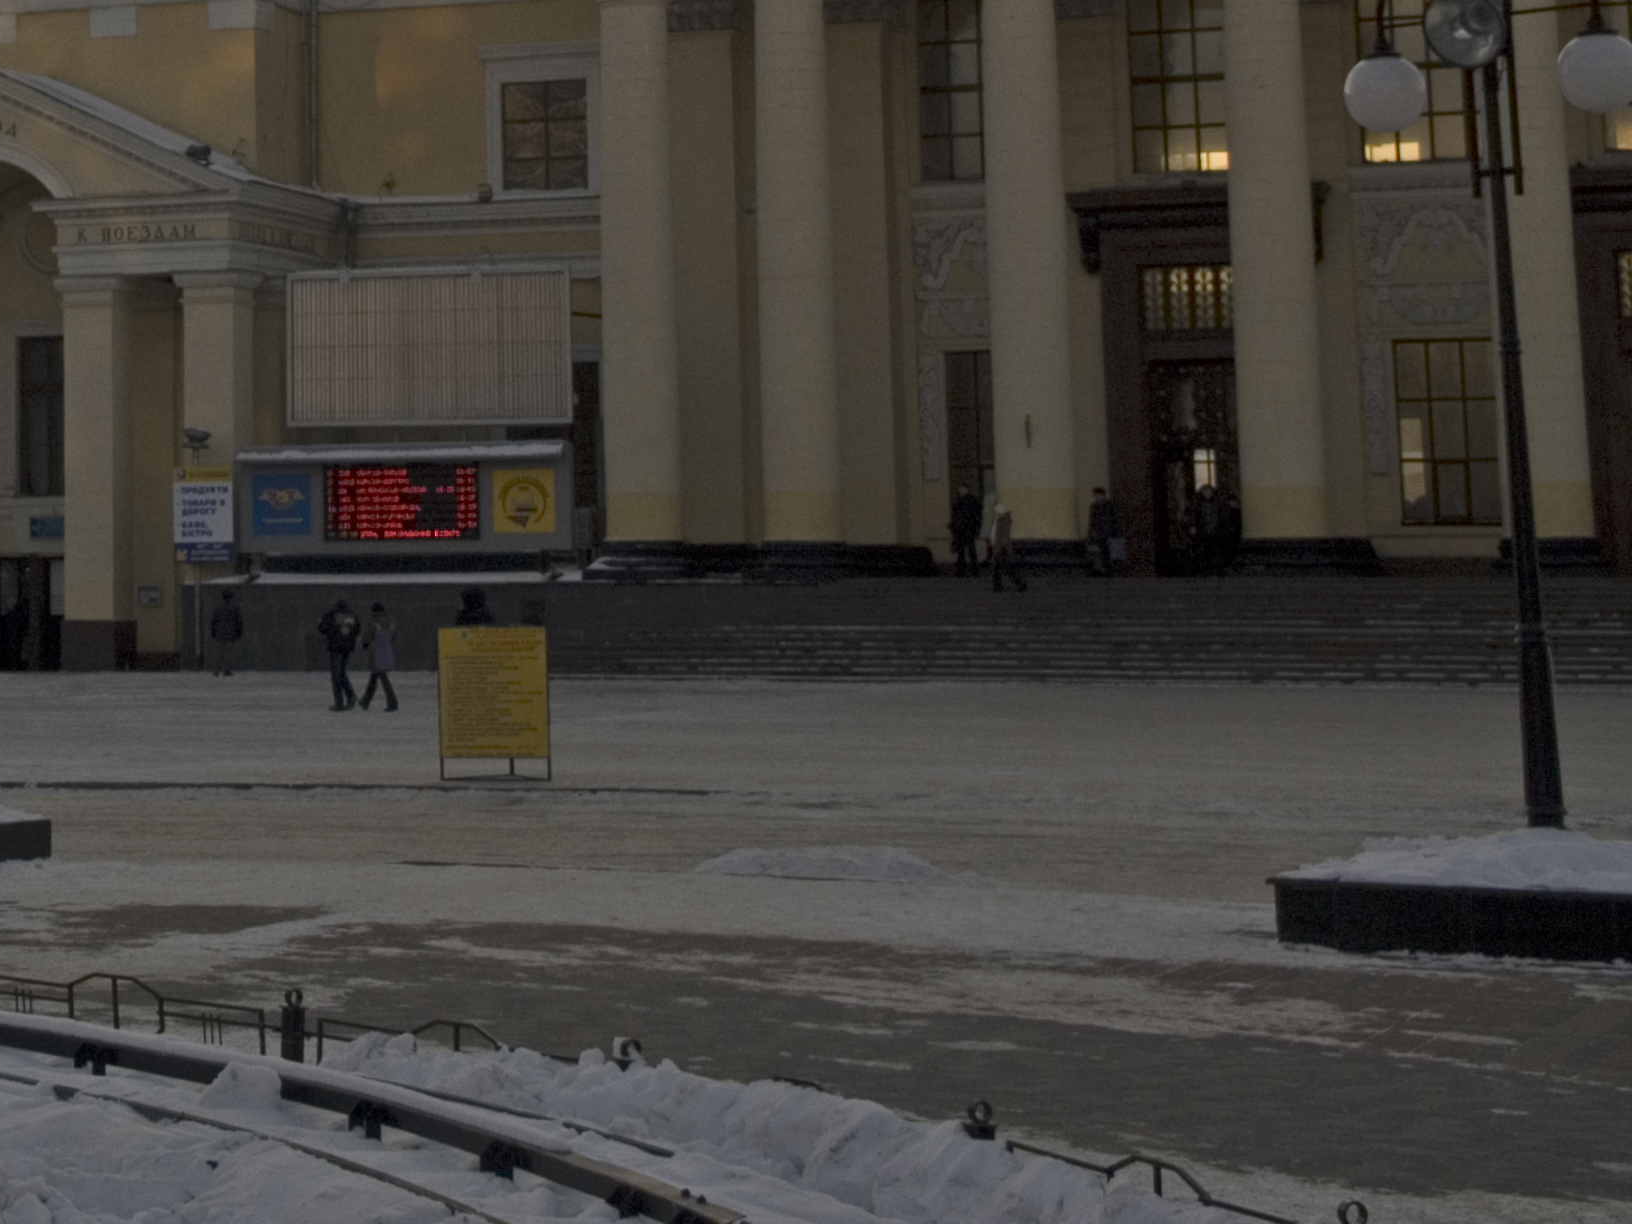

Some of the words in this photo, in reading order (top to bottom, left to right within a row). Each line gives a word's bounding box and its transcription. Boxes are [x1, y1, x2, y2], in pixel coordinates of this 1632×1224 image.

[75, 227, 88, 242] К
[101, 223, 196, 242] ПОЕЗДАМ
[181, 486, 229, 494] ПРОДУКТИ
